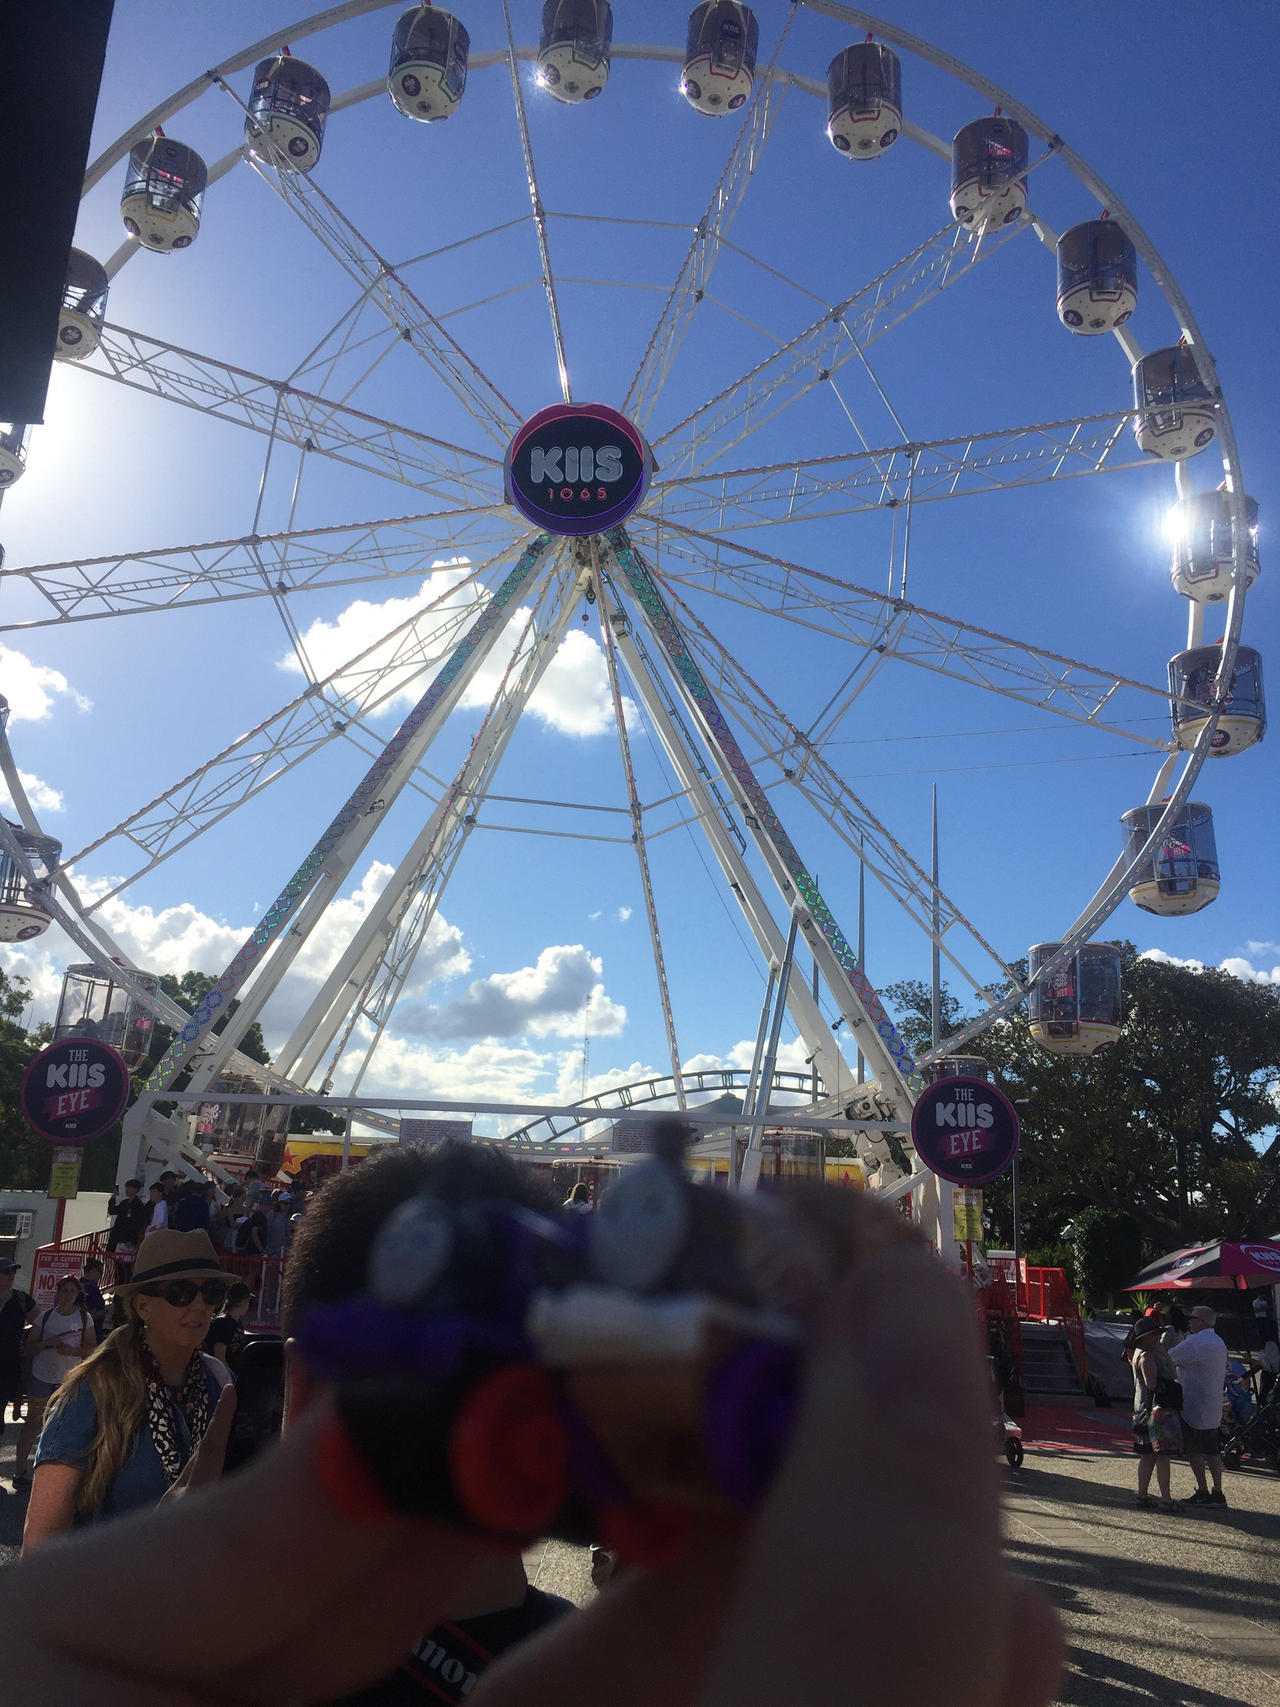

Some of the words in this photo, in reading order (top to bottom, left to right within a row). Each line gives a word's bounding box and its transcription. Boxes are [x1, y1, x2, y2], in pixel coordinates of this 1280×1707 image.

[530, 445, 624, 484] KIIS
[548, 487, 607, 500] 1065
[69, 1050, 89, 1062] THE
[46, 1063, 106, 1089] KIIS
[56, 1089, 92, 1116] EYE
[954, 1088, 974, 1101] THE
[935, 1101, 994, 1128] KIIS
[950, 1129, 982, 1155] EYE
[39, 1275, 55, 1291] NO
